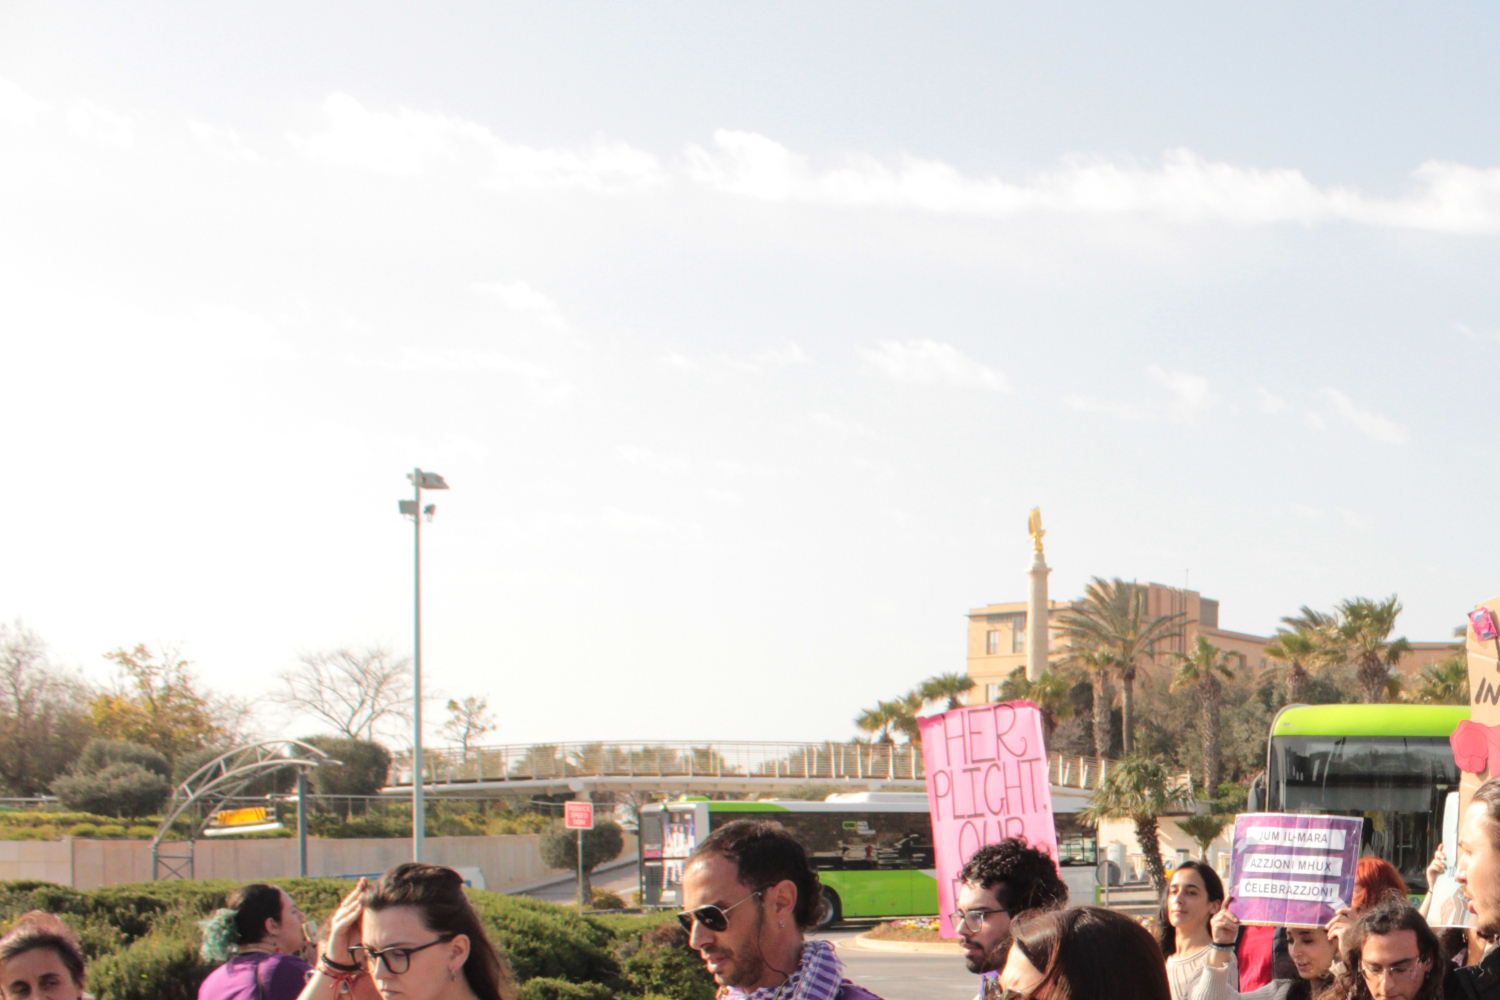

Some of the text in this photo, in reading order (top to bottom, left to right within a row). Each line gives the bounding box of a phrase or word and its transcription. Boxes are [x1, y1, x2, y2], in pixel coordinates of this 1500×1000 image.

[942, 702, 1028, 767] HER
[1259, 831, 1328, 843] JUM IL-MARA
[1250, 858, 1331, 872] AZZJONI MHUX
